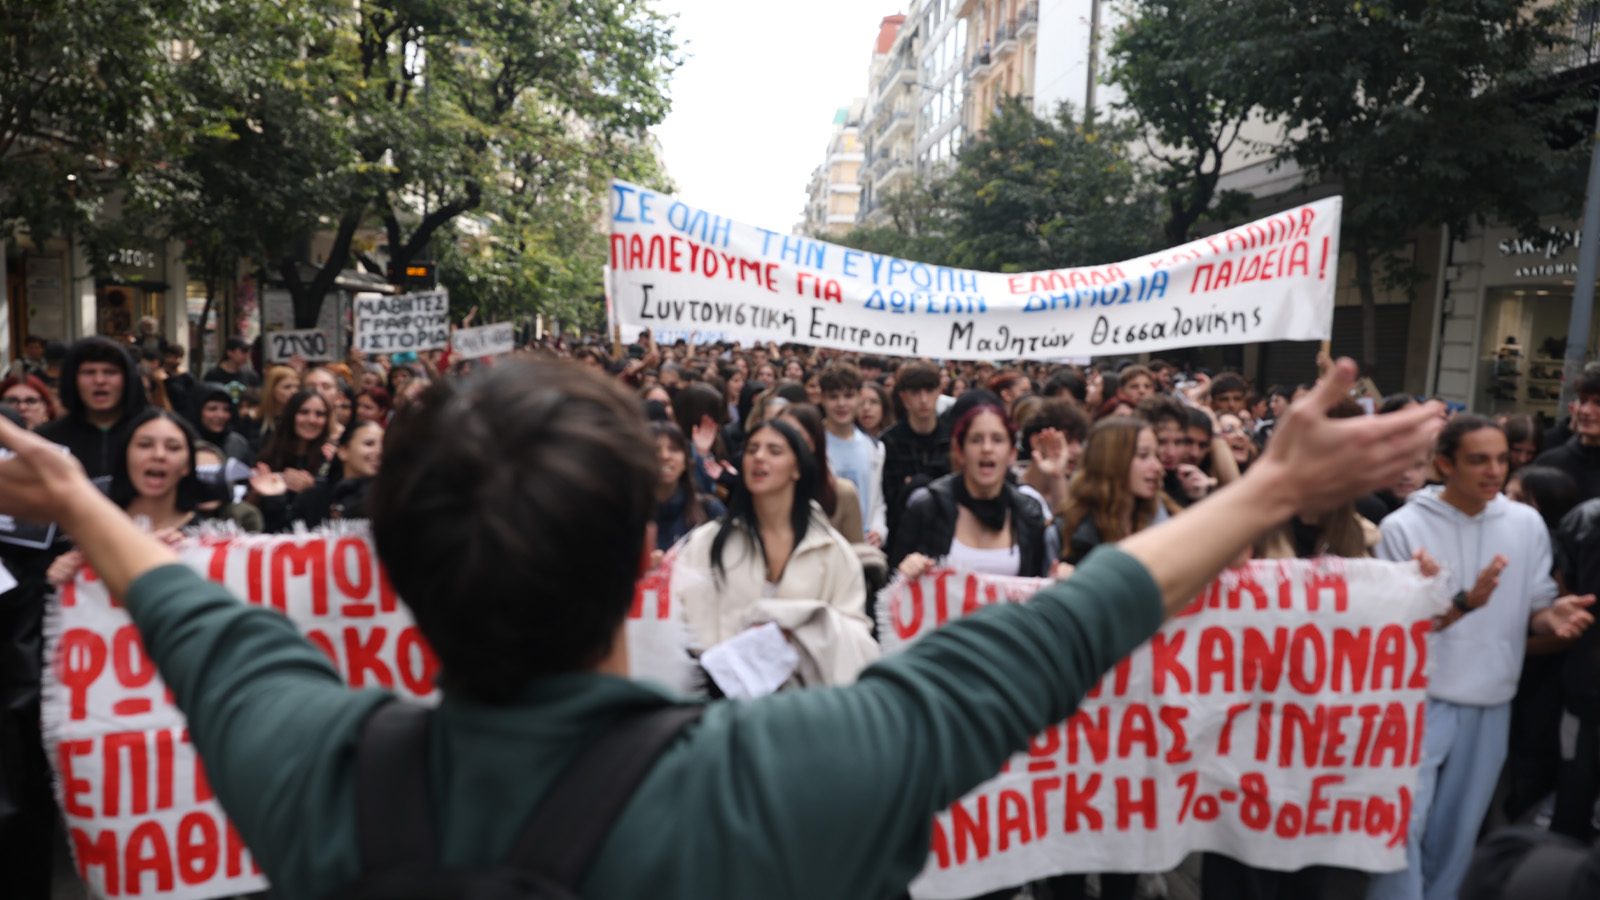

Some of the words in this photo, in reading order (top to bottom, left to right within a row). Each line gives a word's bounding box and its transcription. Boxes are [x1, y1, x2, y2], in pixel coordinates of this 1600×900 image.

[611, 184, 655, 224] ΣΕ
[667, 201, 732, 248] ΟΛΗ
[755, 226, 827, 270] ΤΗΝ
[357, 294, 444, 317] ΜΑΘΗΤΕΣ
[610, 233, 780, 293] ΠΑΛΕΥΟΥΜΕ
[796, 271, 843, 304] ΓΙΑ
[863, 288, 988, 315] ΔΩΡΕΑΝ
[1021, 269, 1170, 313] ΔΗΜΟΣΙΑ
[810, 307, 919, 353] Επιτροπή
[949, 320, 1075, 355] Μαθητών
[1152, 619, 1434, 696] ΚΑΝΟΝΑΣ
[1216, 701, 1425, 768] ΓΙΝΕΤΑΙ
